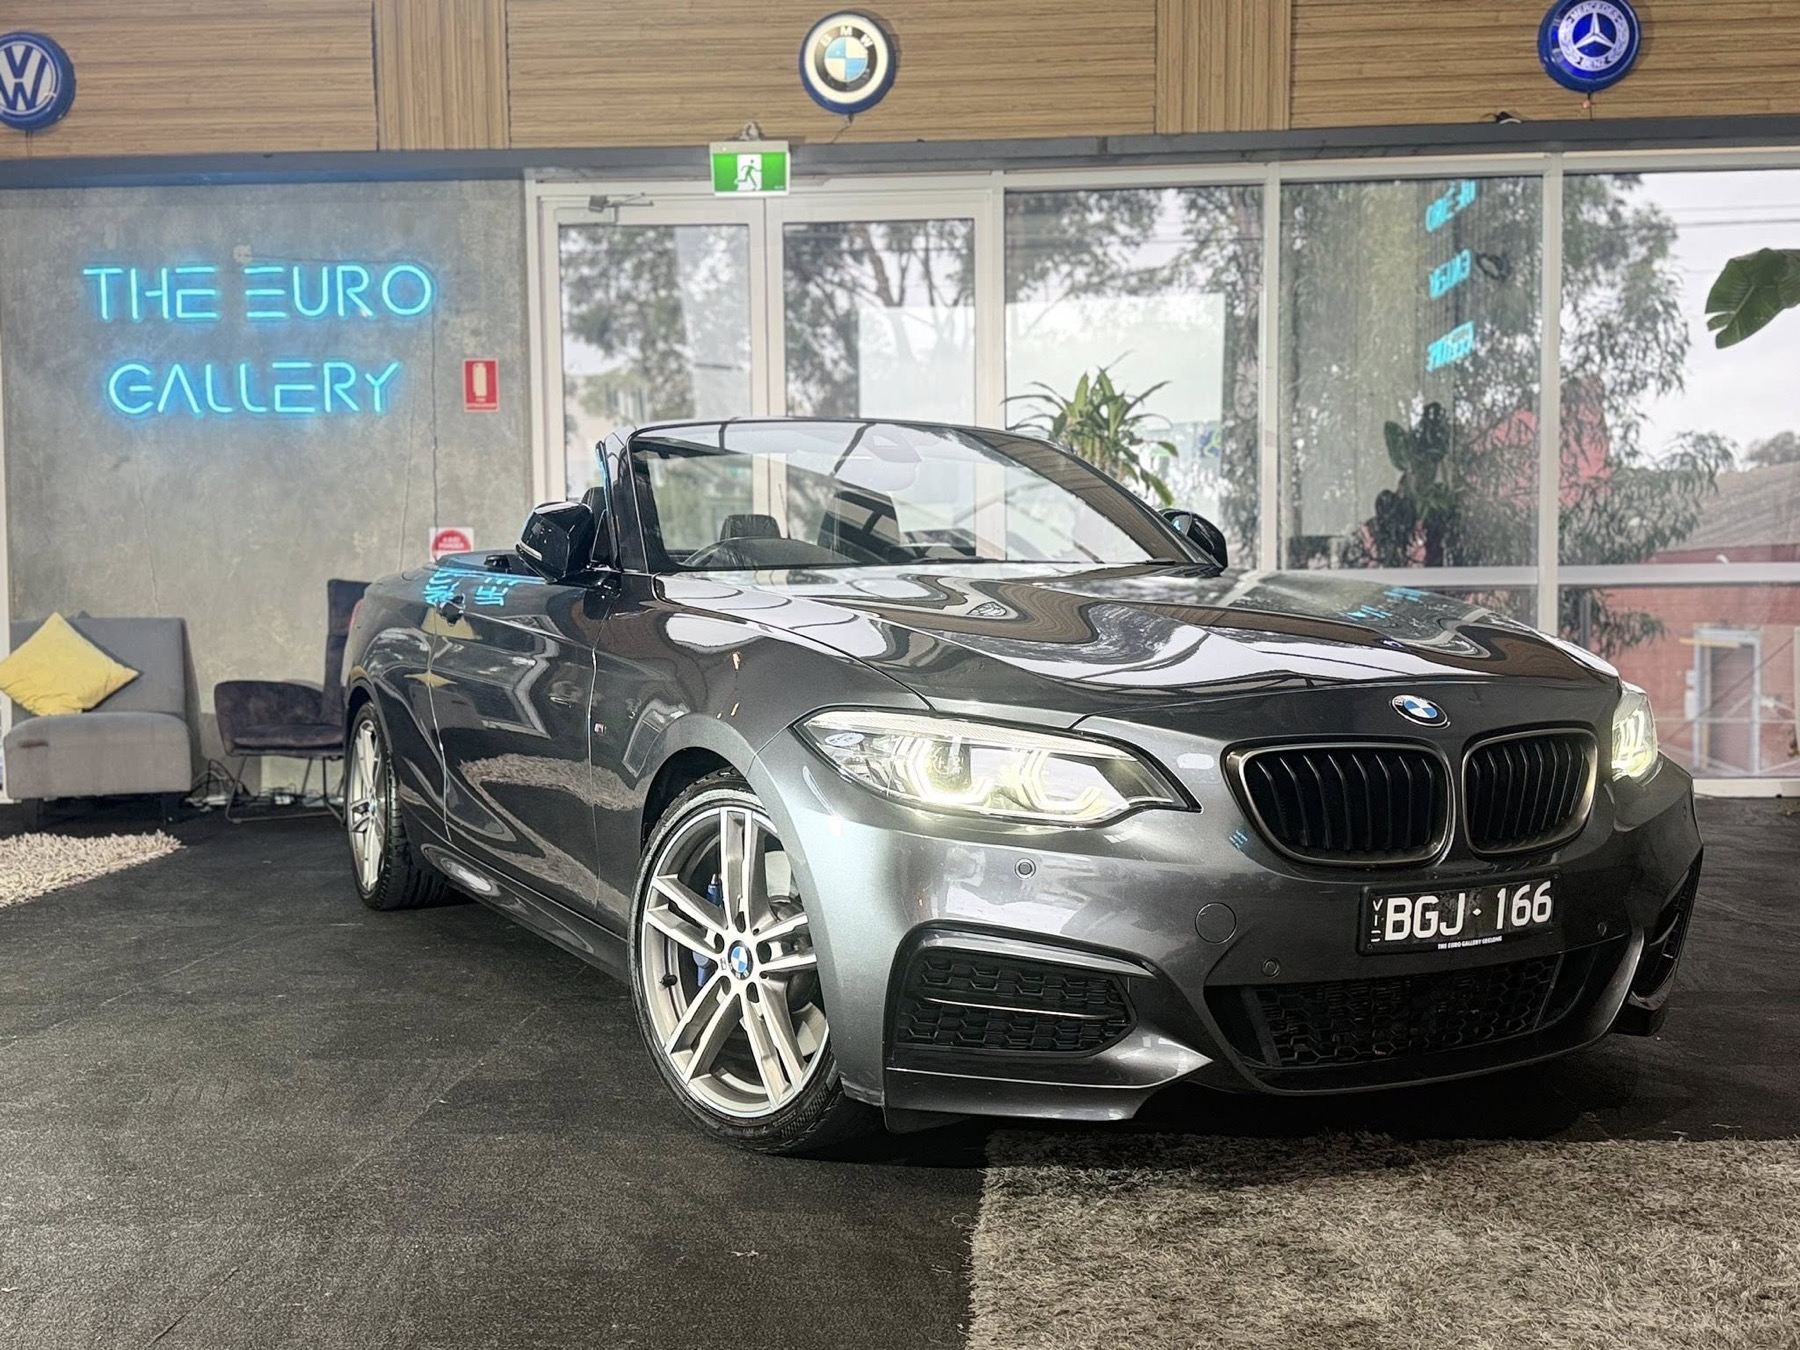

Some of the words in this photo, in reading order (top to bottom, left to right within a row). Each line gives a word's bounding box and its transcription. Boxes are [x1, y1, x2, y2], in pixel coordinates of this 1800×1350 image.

[820, 26, 874, 47] BMW
[84, 266, 218, 320] THE
[244, 264, 432, 318] EURO
[108, 362, 400, 415] GALLERY
[1385, 892, 1466, 941] BGJ
[1497, 880, 1552, 930] 166
